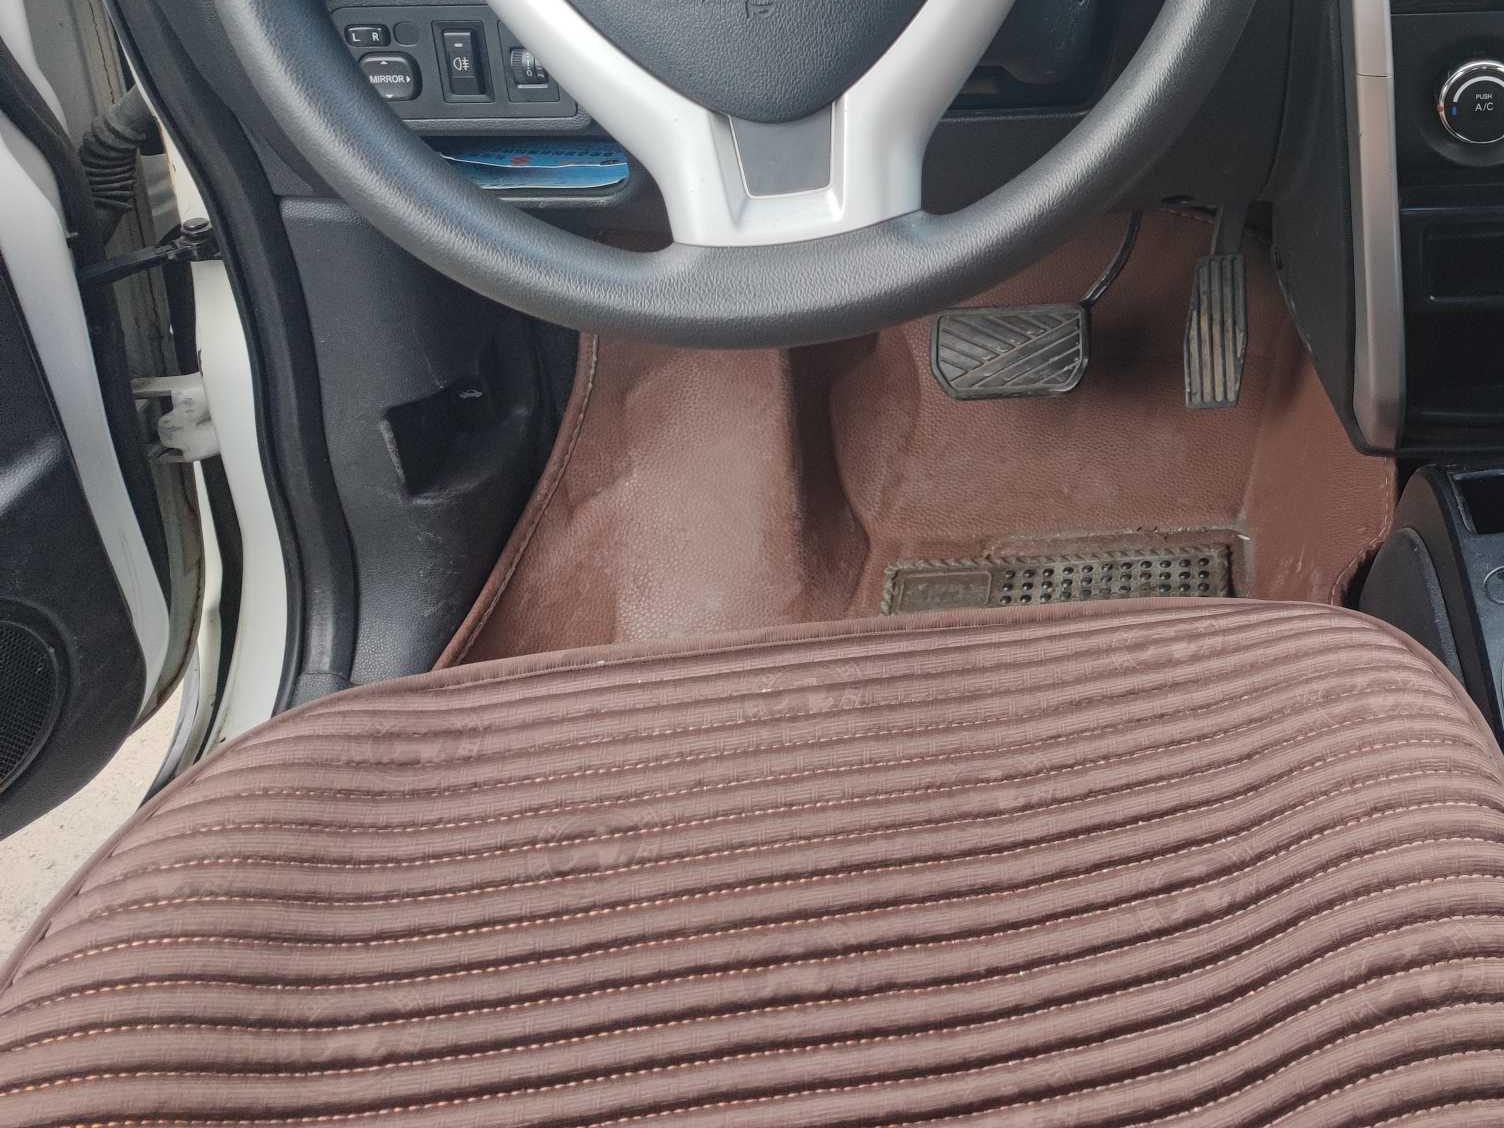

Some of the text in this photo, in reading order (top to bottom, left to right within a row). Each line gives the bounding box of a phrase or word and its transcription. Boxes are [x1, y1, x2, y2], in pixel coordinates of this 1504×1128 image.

[351, 32, 361, 42] L
[371, 32, 380, 41] R
[369, 74, 406, 84] MIRROR
[1475, 102, 1494, 112] A/C
